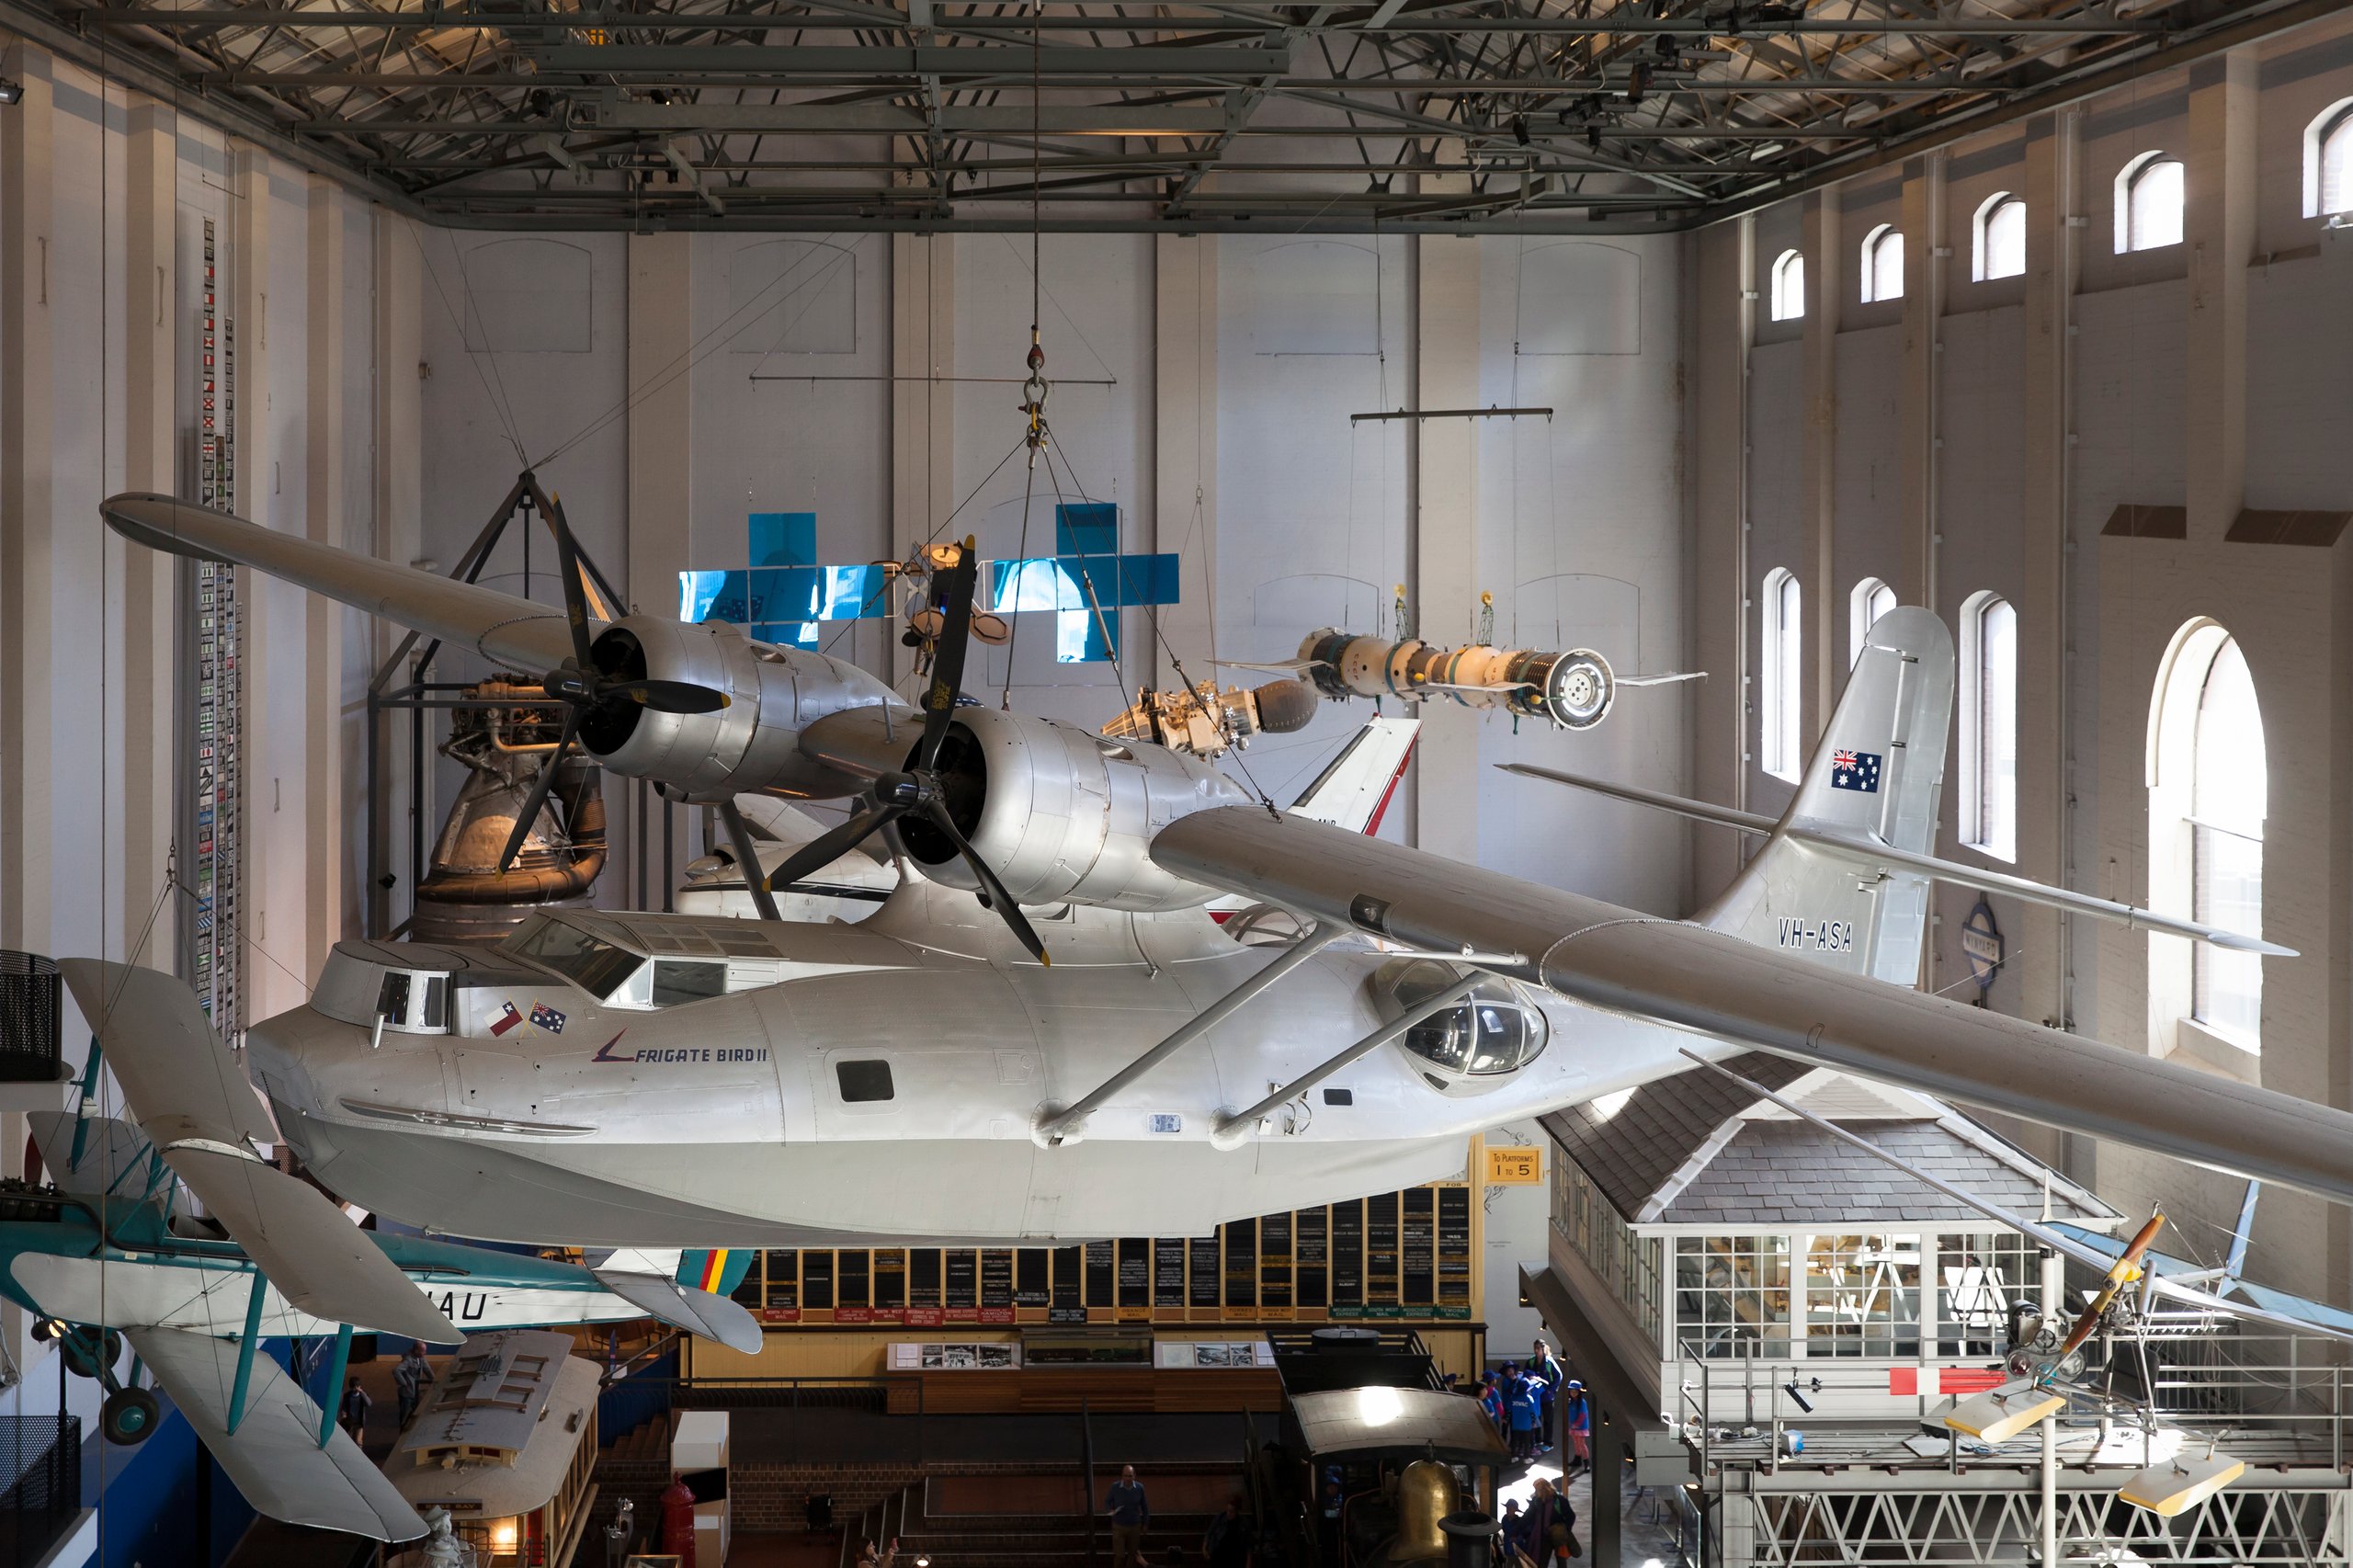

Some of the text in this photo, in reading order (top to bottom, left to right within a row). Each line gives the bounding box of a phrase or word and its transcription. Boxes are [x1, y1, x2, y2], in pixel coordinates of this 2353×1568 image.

[1778, 917, 1853, 952] VH-ASA
[635, 1049, 710, 1062] FRIGATE
[1519, 1165, 1529, 1176] 5
